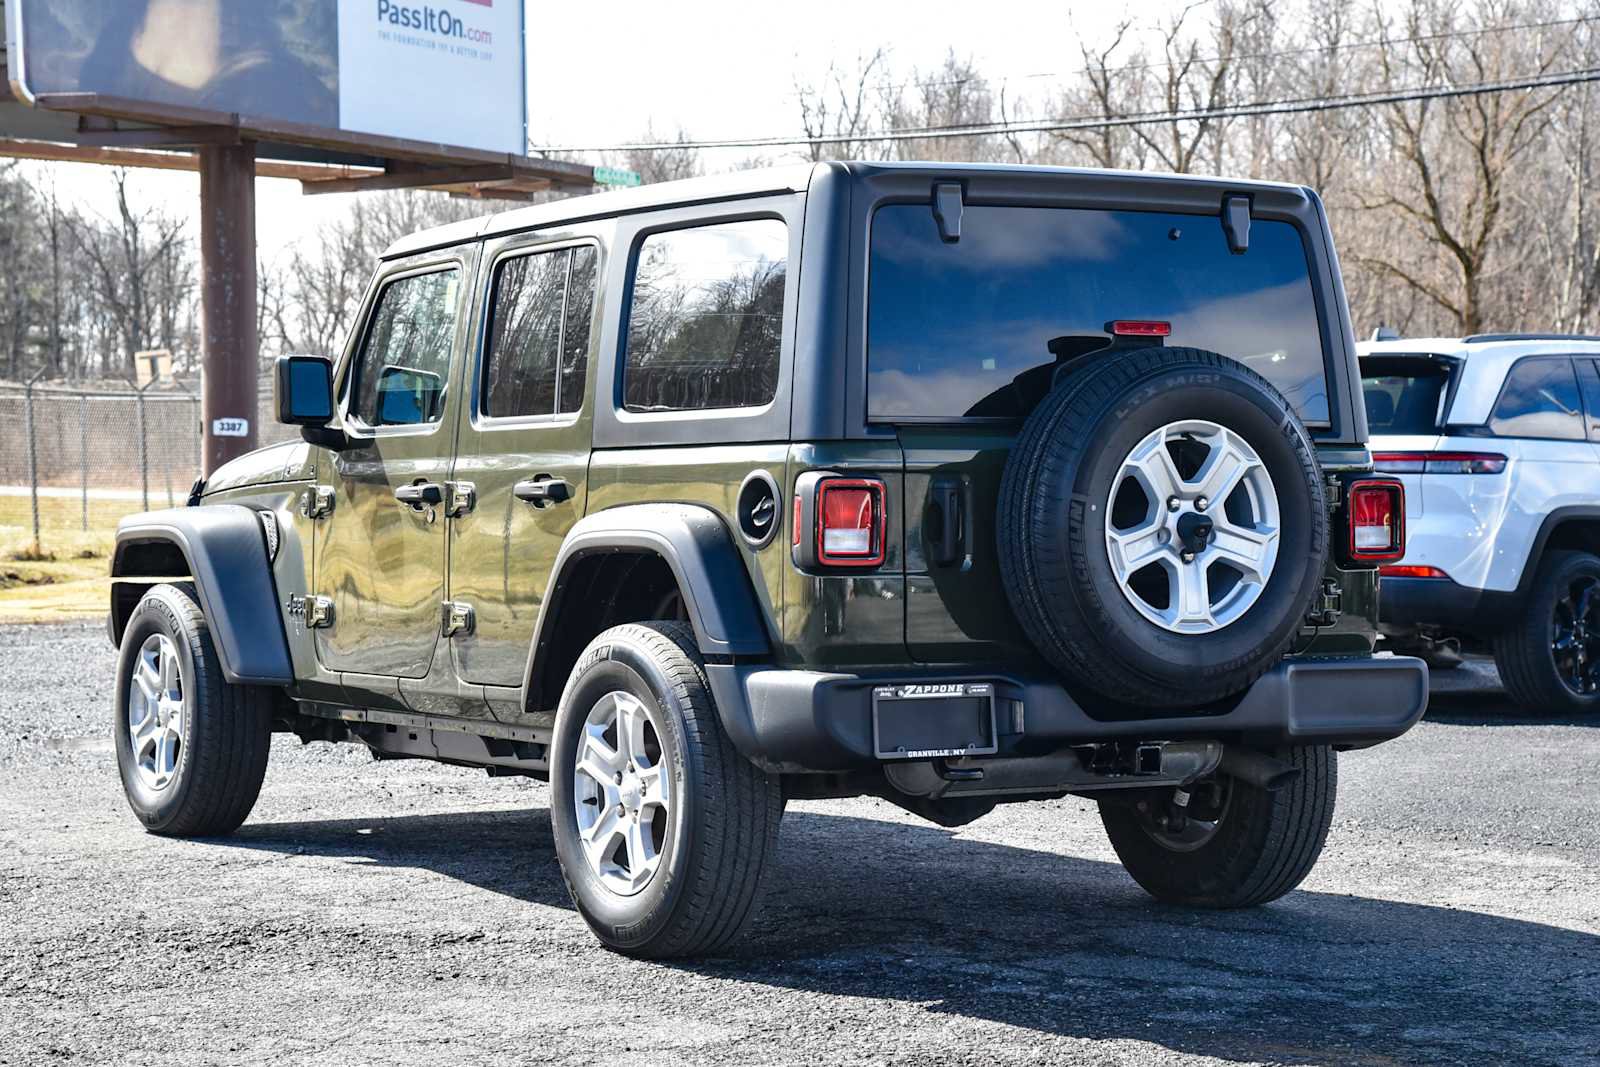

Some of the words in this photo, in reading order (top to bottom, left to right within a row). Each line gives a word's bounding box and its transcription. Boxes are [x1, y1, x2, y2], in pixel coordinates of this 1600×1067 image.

[377, 0, 492, 44] PassItOn.com
[219, 422, 242, 432] 3387
[904, 685, 963, 697] ZAPPONE
[953, 748, 966, 756] NY
